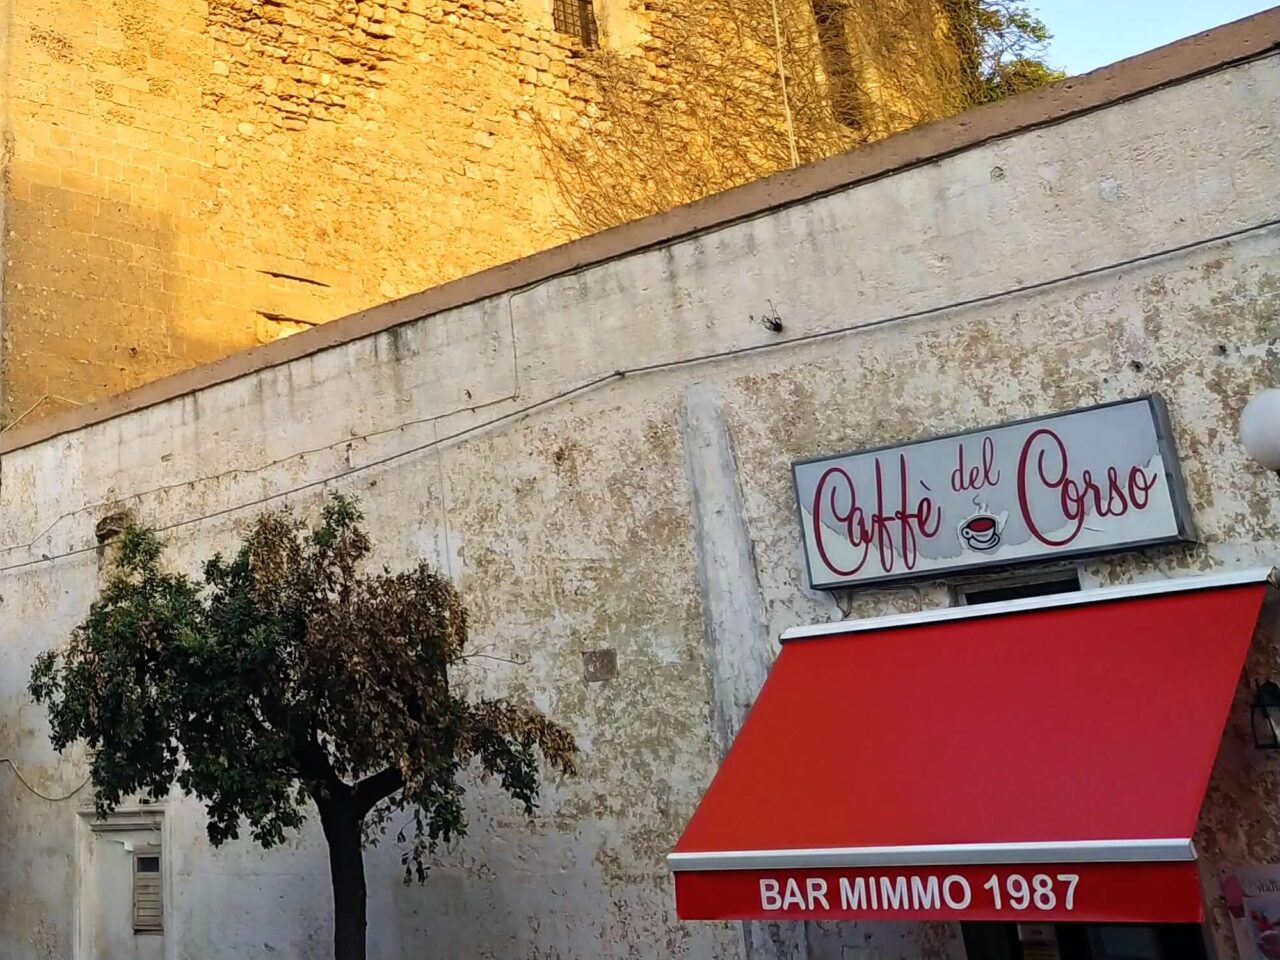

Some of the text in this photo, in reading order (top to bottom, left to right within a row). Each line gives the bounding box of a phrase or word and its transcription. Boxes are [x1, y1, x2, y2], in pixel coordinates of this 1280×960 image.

[813, 428, 1157, 577] Caffè del Corso
[759, 874, 1079, 910] BAR MIMMO 1987
